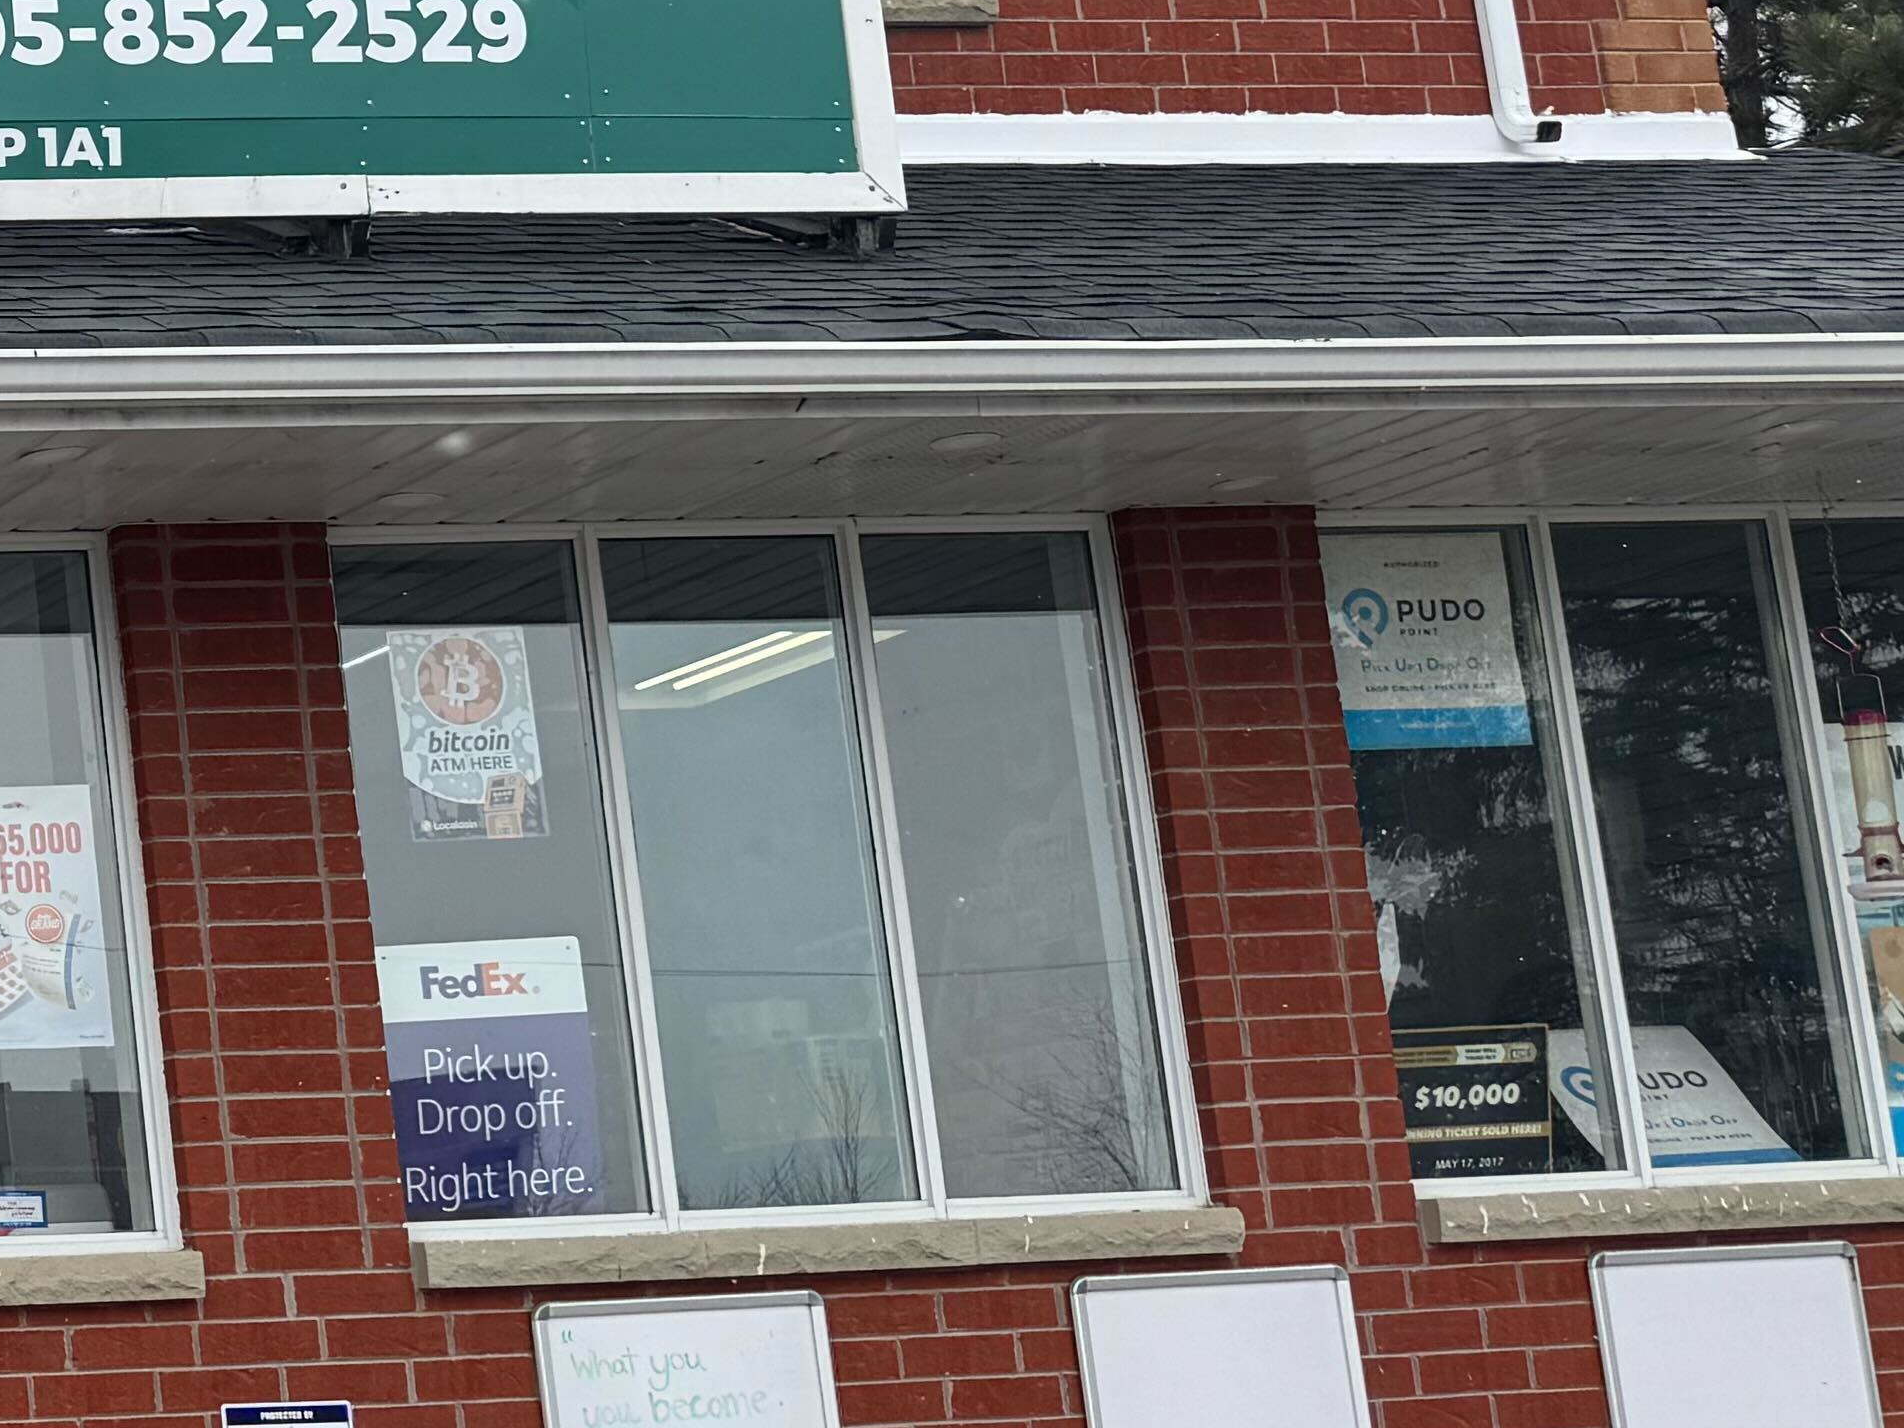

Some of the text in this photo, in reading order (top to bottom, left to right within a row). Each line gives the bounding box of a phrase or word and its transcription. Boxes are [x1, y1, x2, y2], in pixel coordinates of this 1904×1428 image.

[37, 126, 123, 167] 1A1
[1396, 598, 1485, 622] PUDO
[427, 729, 510, 755] bitcoin
[430, 755, 513, 773] ATM HERE
[0, 860, 52, 894] FOR
[418, 961, 529, 1000] FedEx
[423, 1044, 558, 1089] Pick up.
[1637, 1070, 1708, 1090] UDO
[1414, 1081, 1521, 1111] $10,000
[417, 1088, 573, 1142] Drop off.
[1444, 1124, 1510, 1138] TICKET SOLD
[1434, 1156, 1505, 1170] MAY 17, 2017
[405, 1159, 594, 1212] Right here.
[570, 1346, 707, 1392] What you
